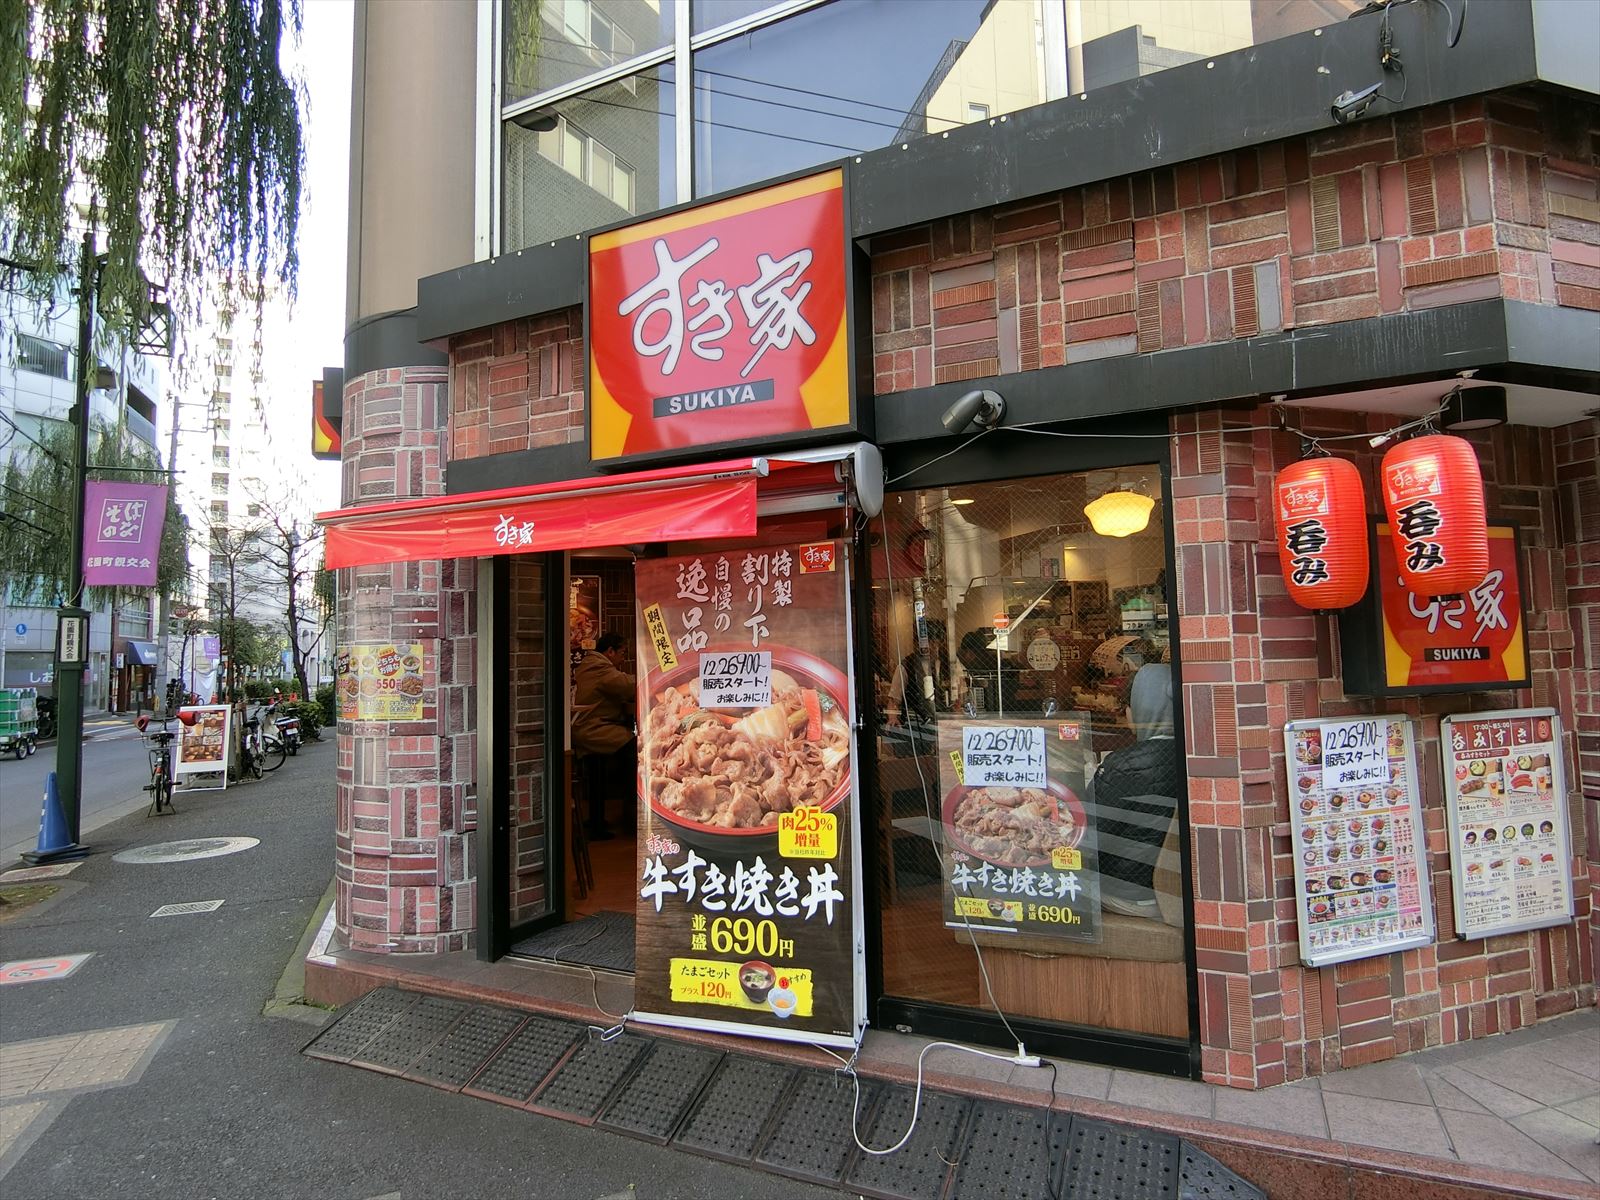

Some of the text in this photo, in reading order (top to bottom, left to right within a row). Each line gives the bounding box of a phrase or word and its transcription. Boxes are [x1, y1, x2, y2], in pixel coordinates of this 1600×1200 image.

[617, 237, 817, 379] すき家
[669, 384, 756, 415] SUKIYA
[494, 514, 535, 548] すき家
[1286, 518, 1331, 586] 呑み
[1396, 500, 1446, 573] 呑み
[676, 558, 710, 654] 逸品
[711, 556, 733, 632] 自慢の
[740, 553, 770, 648] 割り下
[771, 549, 793, 607] 特製
[647, 606, 675, 668] 期間限定
[1433, 647, 1481, 661] SUKIYA
[782, 808, 832, 831] 肉25%
[795, 833, 820, 847] 増量
[640, 849, 844, 926] 牛すき焼き丼
[952, 861, 1082, 902] 牛すき焼き丼
[691, 914, 794, 958] 並盛 690円
[681, 965, 730, 980] たまごセット
